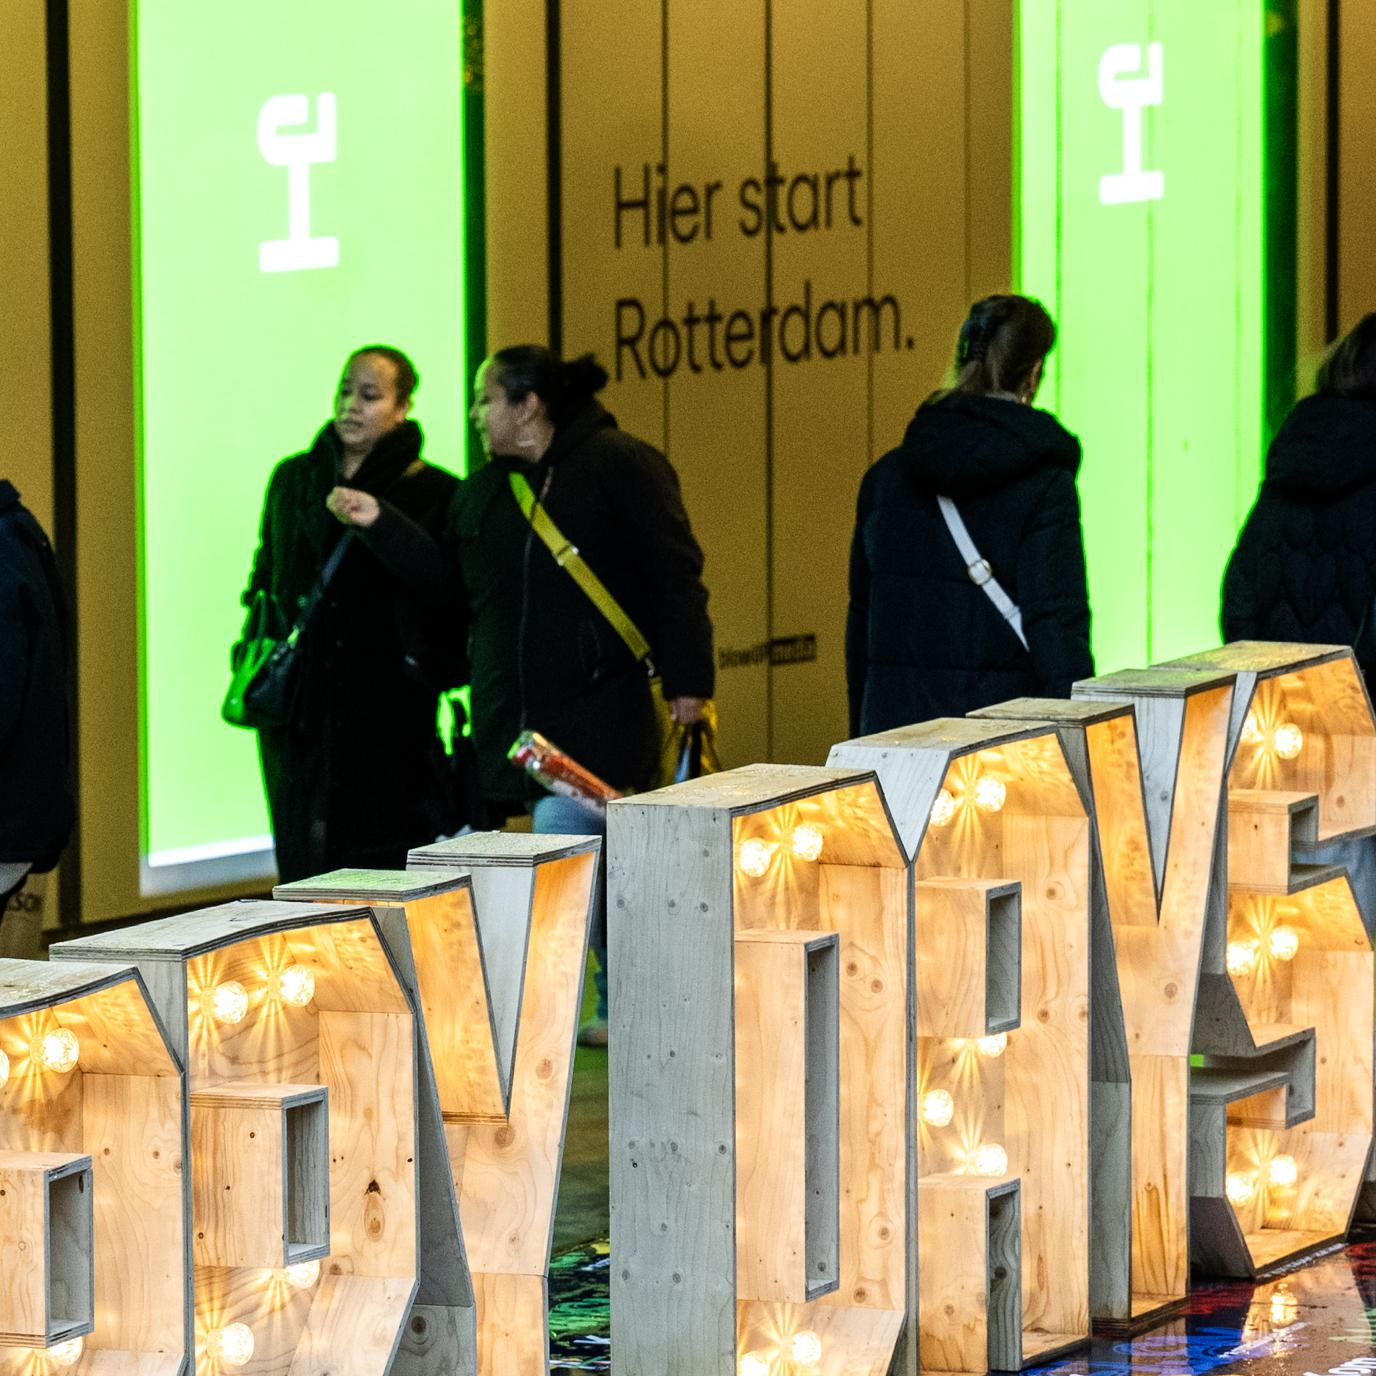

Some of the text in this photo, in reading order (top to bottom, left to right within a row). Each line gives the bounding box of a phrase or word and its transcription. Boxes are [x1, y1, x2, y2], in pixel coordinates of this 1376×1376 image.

[616, 155, 864, 249] Hier start
[616, 280, 917, 383] Rotterdam.
